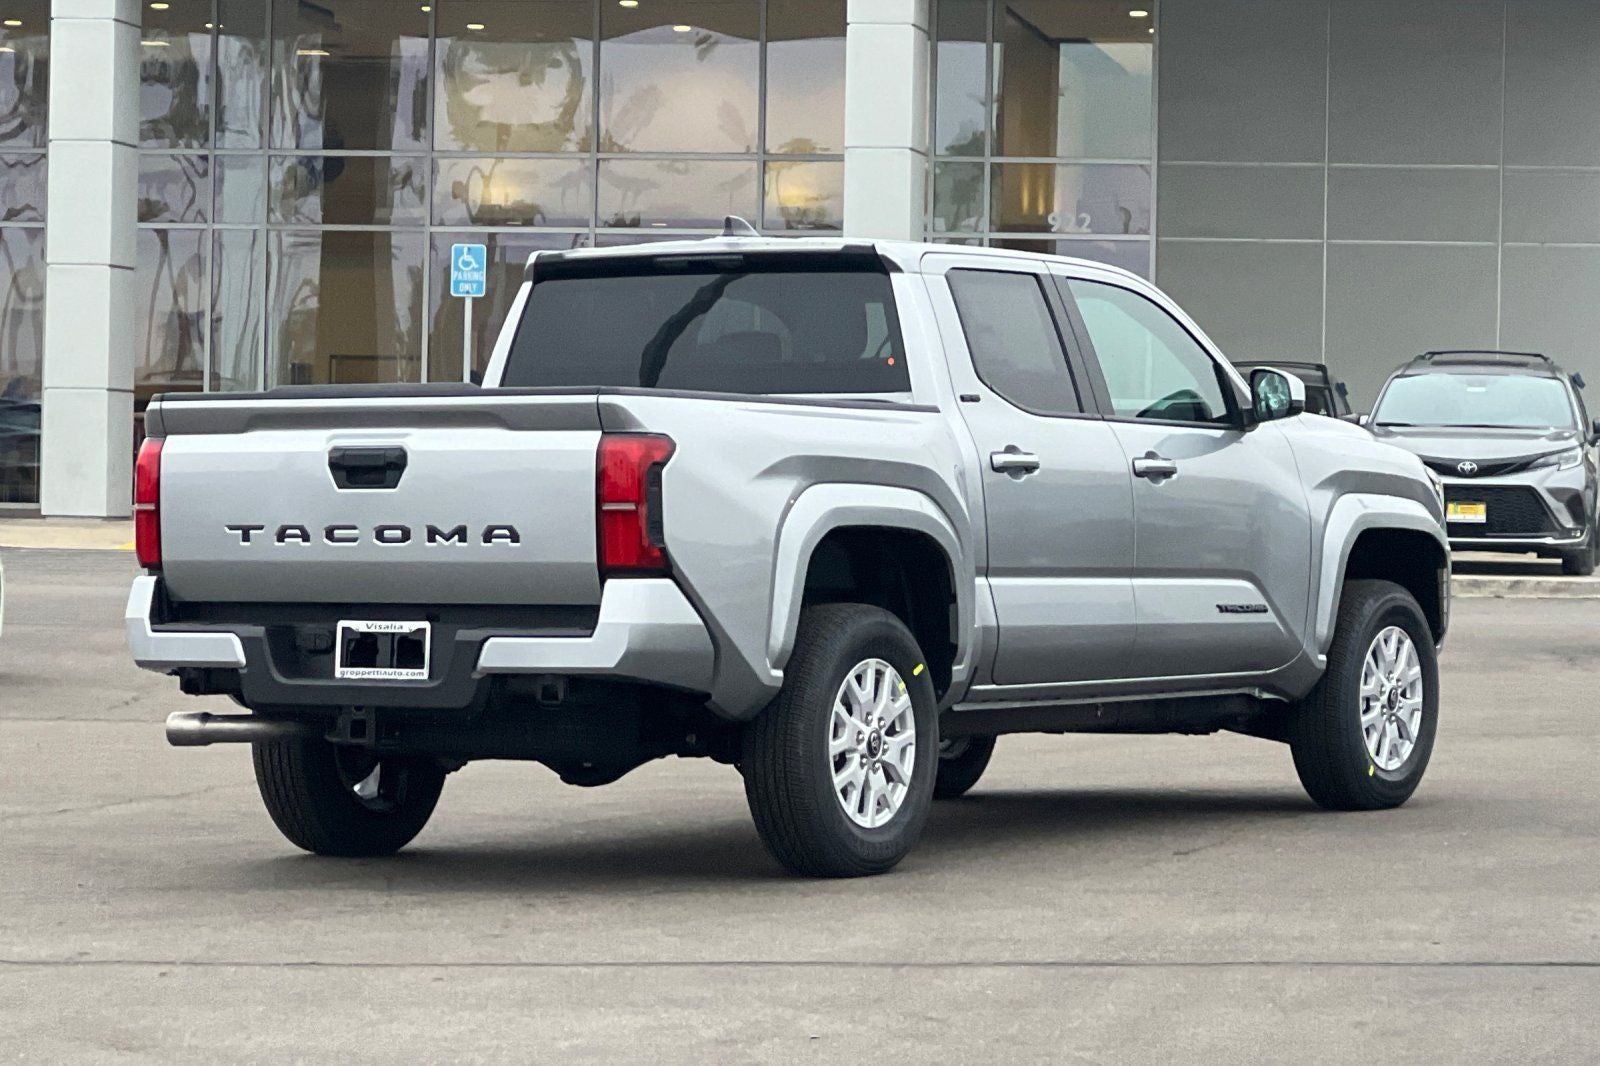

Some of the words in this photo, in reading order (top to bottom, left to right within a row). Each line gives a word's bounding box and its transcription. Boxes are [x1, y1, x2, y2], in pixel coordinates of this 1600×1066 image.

[453, 270, 484, 281] PARKING
[459, 282, 478, 293] ONLY
[224, 524, 521, 547] TACOMA
[340, 669, 425, 678] groppettiauto.com
